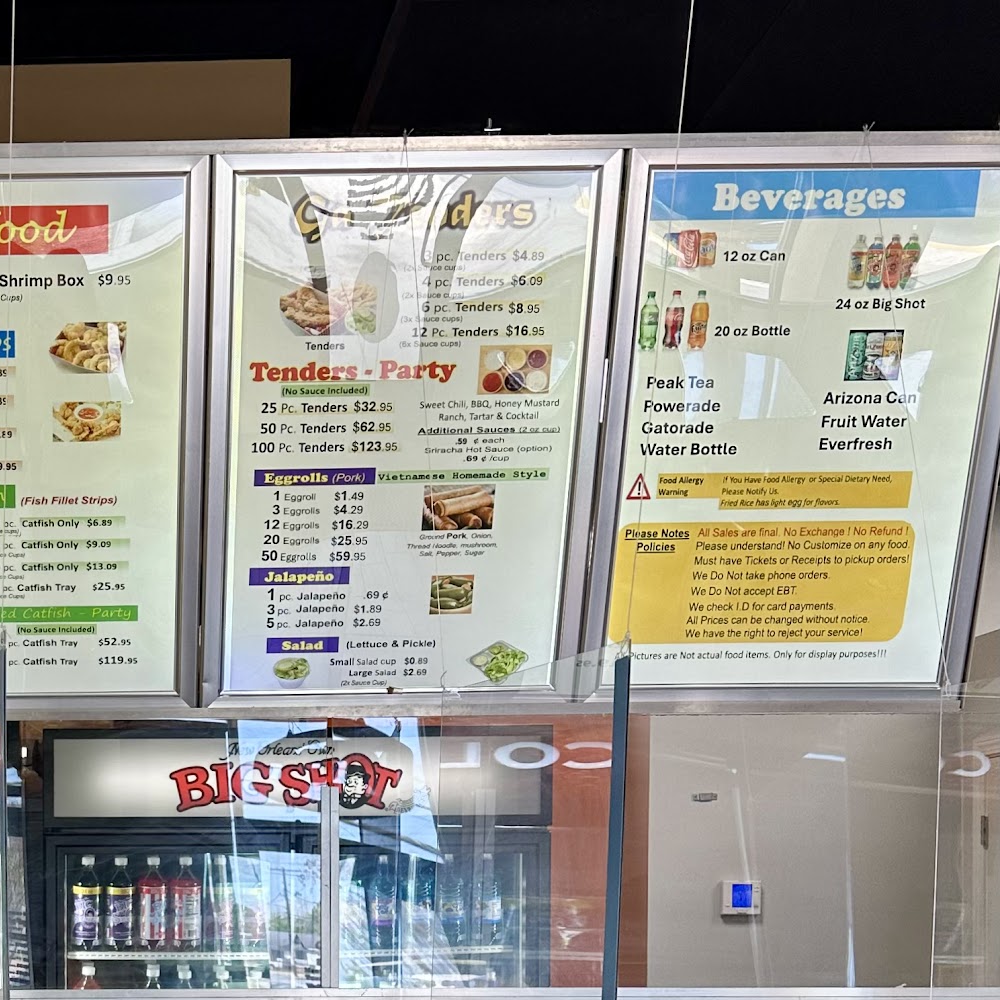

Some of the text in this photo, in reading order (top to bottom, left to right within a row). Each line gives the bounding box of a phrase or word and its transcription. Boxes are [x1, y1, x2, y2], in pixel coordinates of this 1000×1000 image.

[712, 183, 906, 217] Beverages
[723, 250, 786, 262] 12 oz Can
[57, 274, 84, 287] Box
[98, 274, 131, 287] $9.95
[714, 325, 791, 337] 20 oz Bottle
[249, 361, 358, 383] Tenders
[379, 360, 456, 383] Party
[823, 391, 917, 405] Arizona Can
[643, 401, 721, 413] Powerade
[260, 421, 392, 434] 50 Pc. Tenders $62.95
[821, 415, 907, 429] Fruit Water
[819, 437, 892, 451] Everfresh
[263, 472, 366, 485] Eggrolls (Pork)
[659, 476, 704, 486] Food Allergy
[20, 495, 118, 506] (Fish Fillet Strips)
[273, 491, 364, 503] 1 Eggroll $1.49
[625, 529, 690, 539] Please Notes
[264, 570, 335, 584] Jalapeño
[692, 571, 830, 583] We Do Not take phone orders.
[2, 584, 14, 593] pc.
[17, 583, 54, 593] Catfish
[56, 583, 76, 593] Tray
[92, 582, 125, 592] $25.95
[281, 638, 436, 651] Salad (Lettuce & Pickle)
[170, 764, 276, 813] BIG
